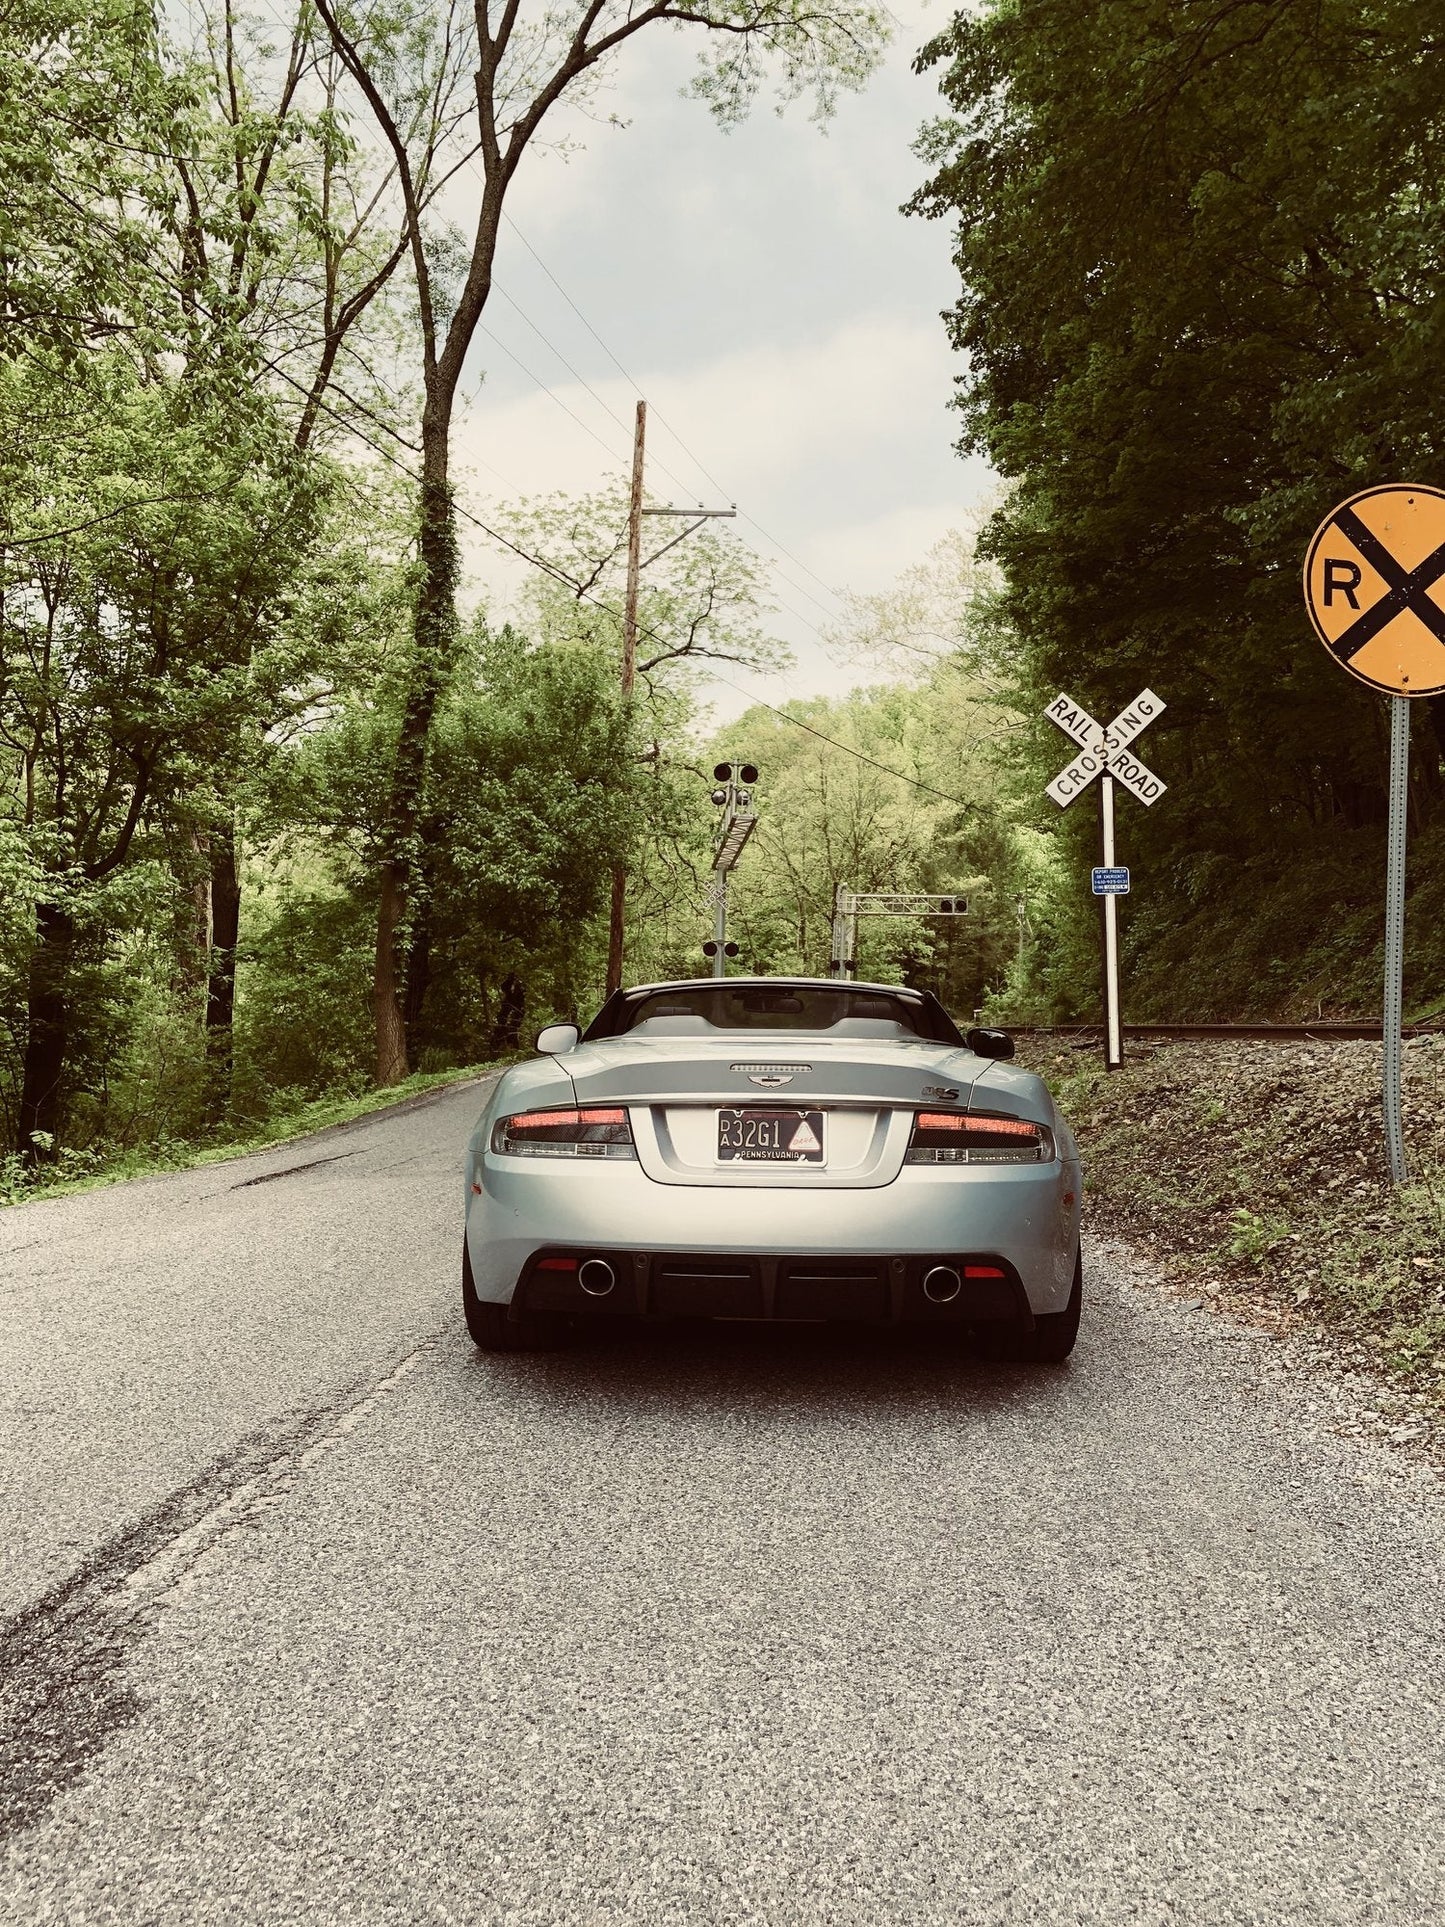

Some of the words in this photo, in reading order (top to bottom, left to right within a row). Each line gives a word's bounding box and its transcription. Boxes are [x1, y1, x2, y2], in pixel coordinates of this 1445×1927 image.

[1323, 557, 1363, 611] R
[1050, 698, 1093, 743] RAIL
[1111, 753, 1160, 799] ROAD
[1056, 700, 1154, 796] CROSSING
[740, 1150, 800, 1159] PENNSYLVANIA
